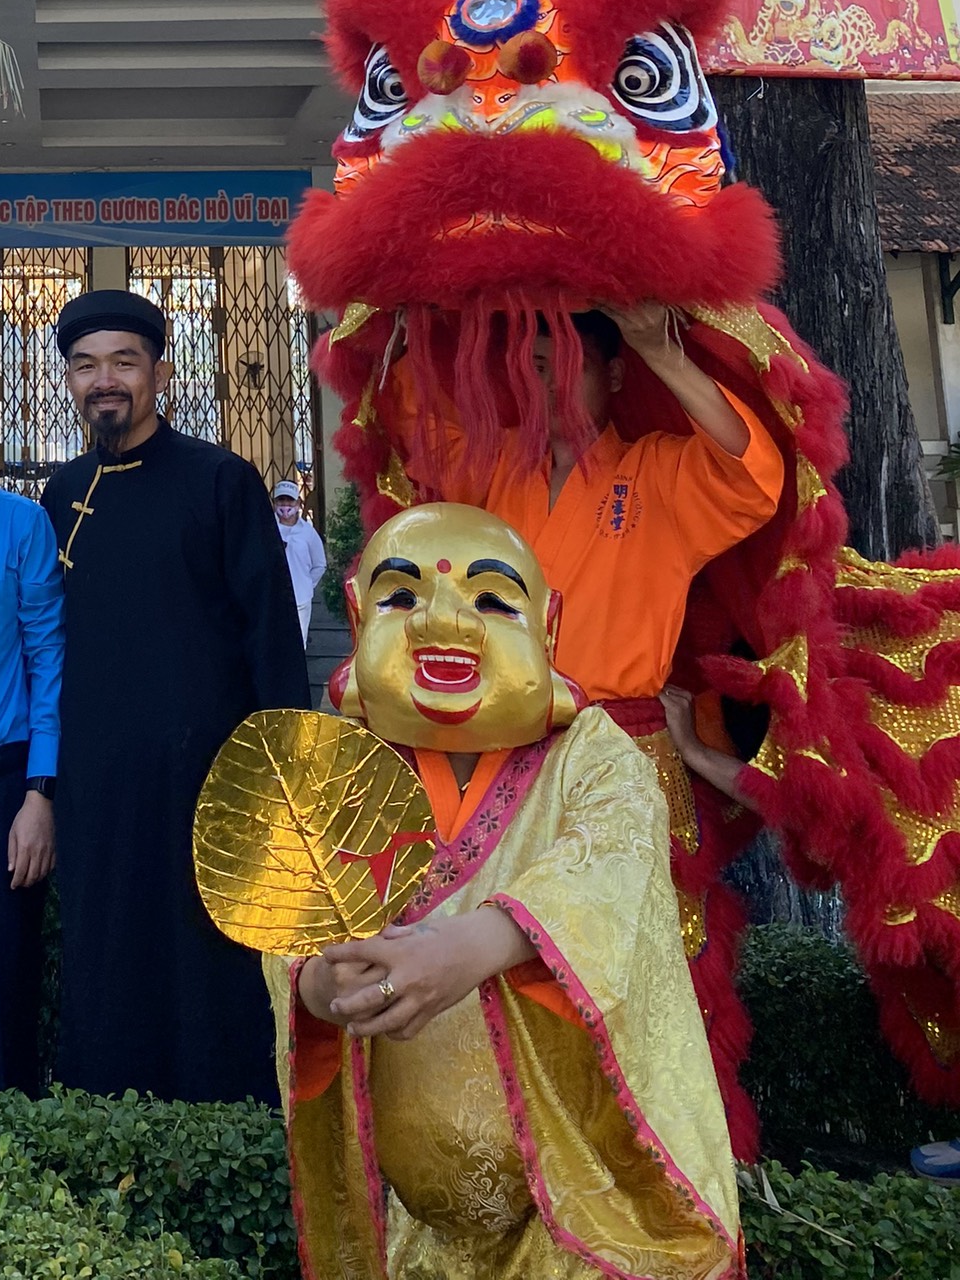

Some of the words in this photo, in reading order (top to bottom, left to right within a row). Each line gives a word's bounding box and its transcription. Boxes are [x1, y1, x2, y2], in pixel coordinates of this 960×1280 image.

[15, 197, 47, 226] TẬP
[52, 200, 95, 222] THEO
[101, 197, 160, 222] GƯƠNG
[165, 194, 200, 222] BÁC
[205, 191, 230, 222] HỒ
[257, 198, 289, 225] ĐẠI
